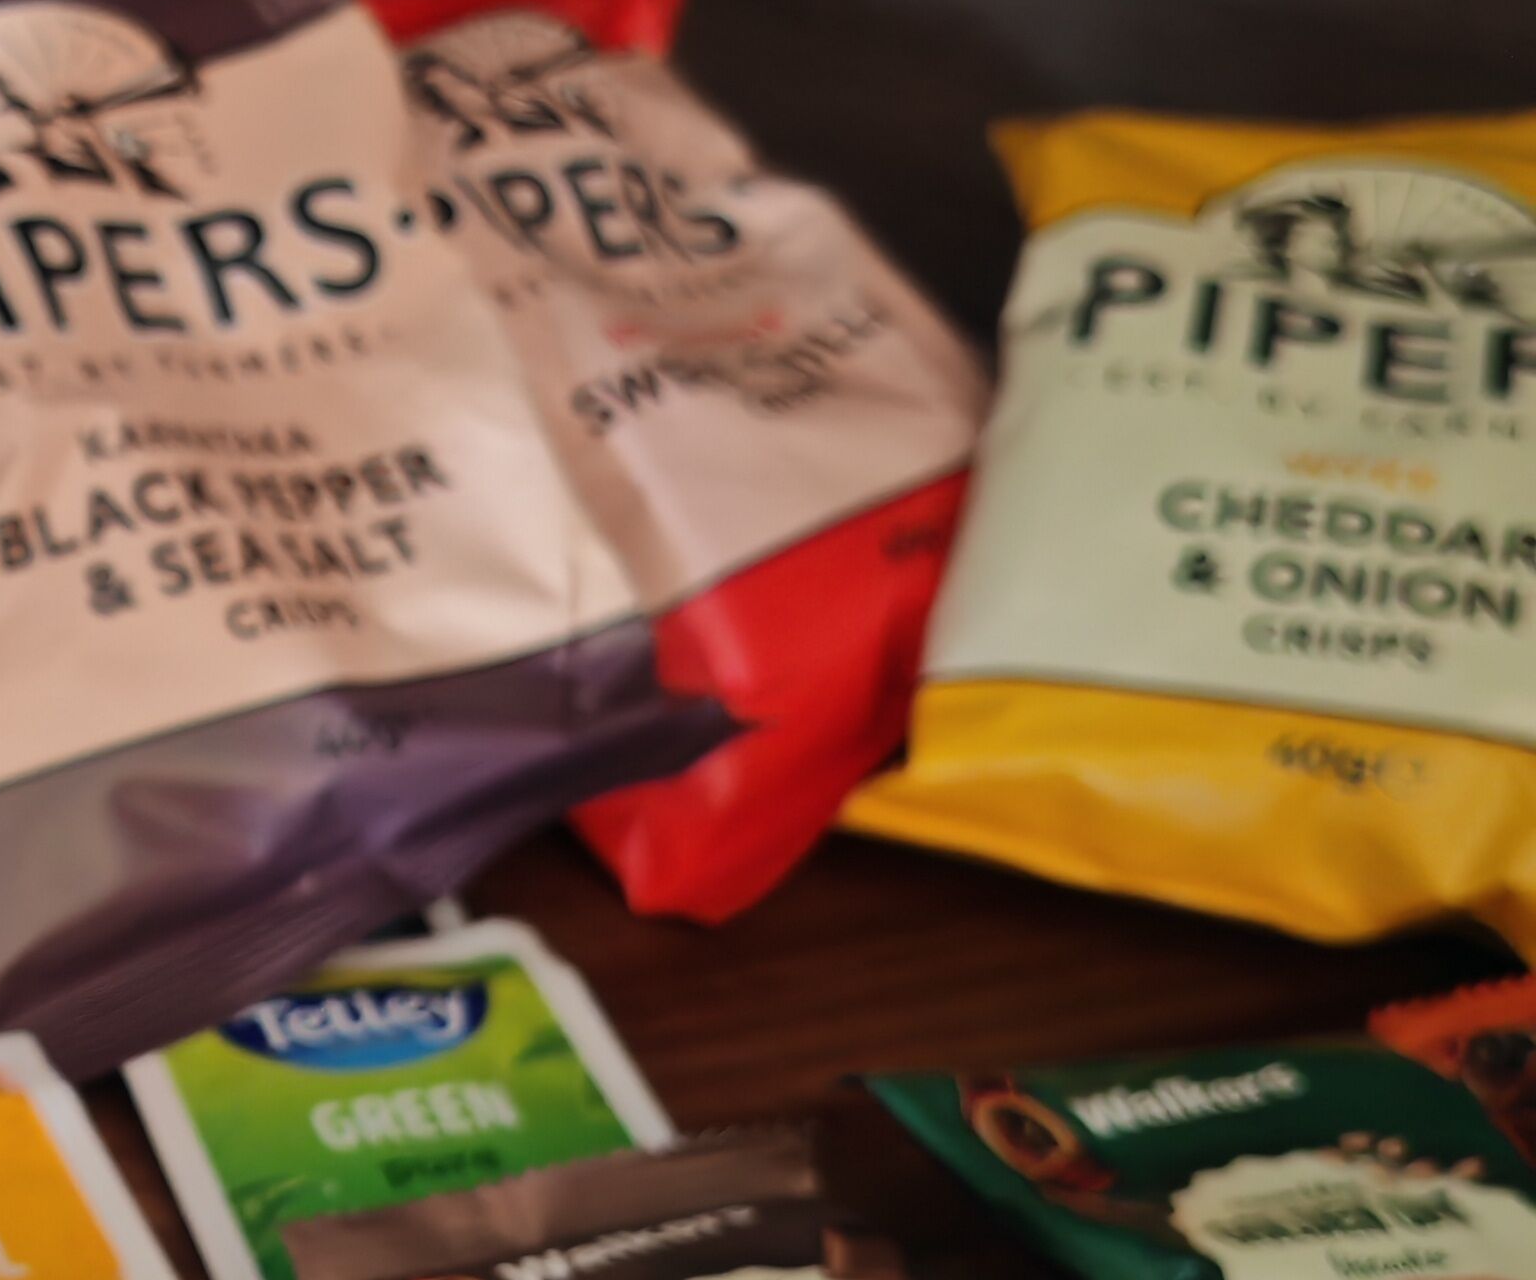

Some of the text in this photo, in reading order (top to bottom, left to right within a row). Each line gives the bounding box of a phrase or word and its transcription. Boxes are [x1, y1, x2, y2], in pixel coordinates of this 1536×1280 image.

[83, 560, 139, 618] &
[149, 530, 269, 598] SEA
[1248, 549, 1521, 631] ONION
[309, 1081, 522, 1152] GREEN
